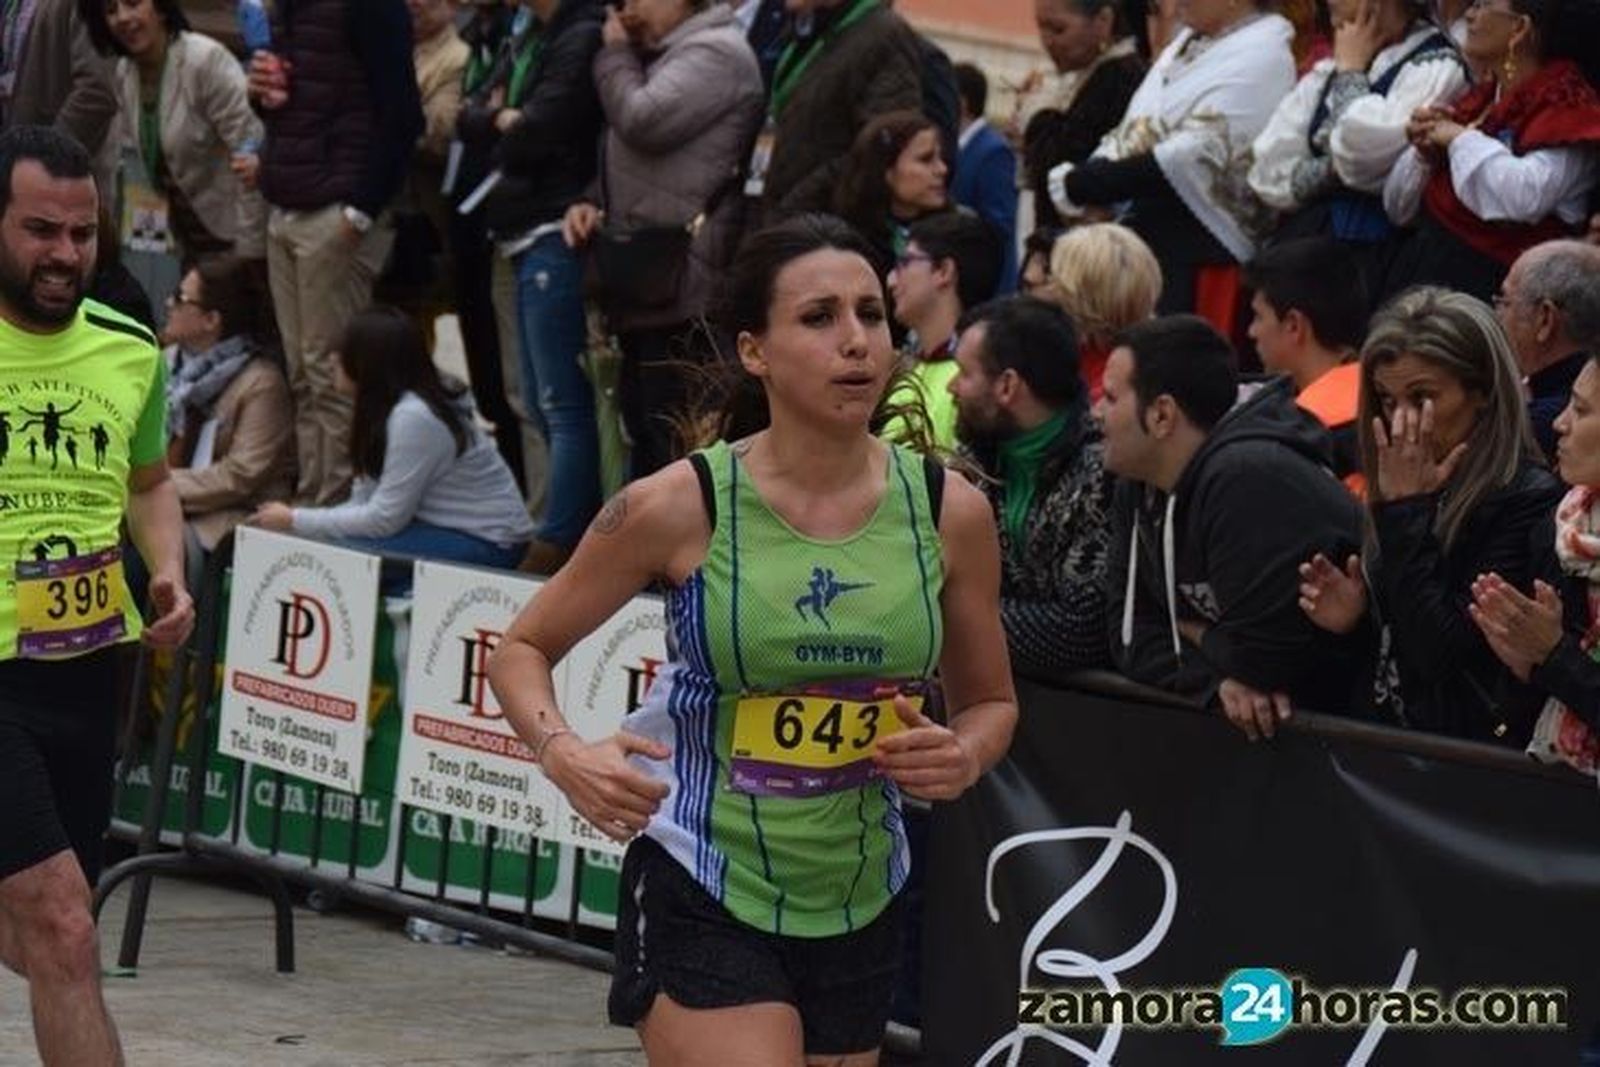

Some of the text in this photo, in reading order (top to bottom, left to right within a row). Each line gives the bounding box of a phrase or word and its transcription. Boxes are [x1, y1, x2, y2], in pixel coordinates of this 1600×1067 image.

[47, 570, 108, 620] 396
[796, 645, 884, 665] GYM-BYM
[247, 706, 338, 752] Toro (Zamora)
[773, 698, 881, 754] 643
[261, 739, 287, 762] 980
[290, 747, 308, 767] 69
[312, 753, 328, 773] 19
[331, 759, 349, 780] 38
[428, 752, 530, 797] Toro (Zamora)
[445, 785, 472, 810] 980
[477, 795, 496, 815] 69
[502, 801, 519, 820] 19
[524, 804, 544, 827] 38
